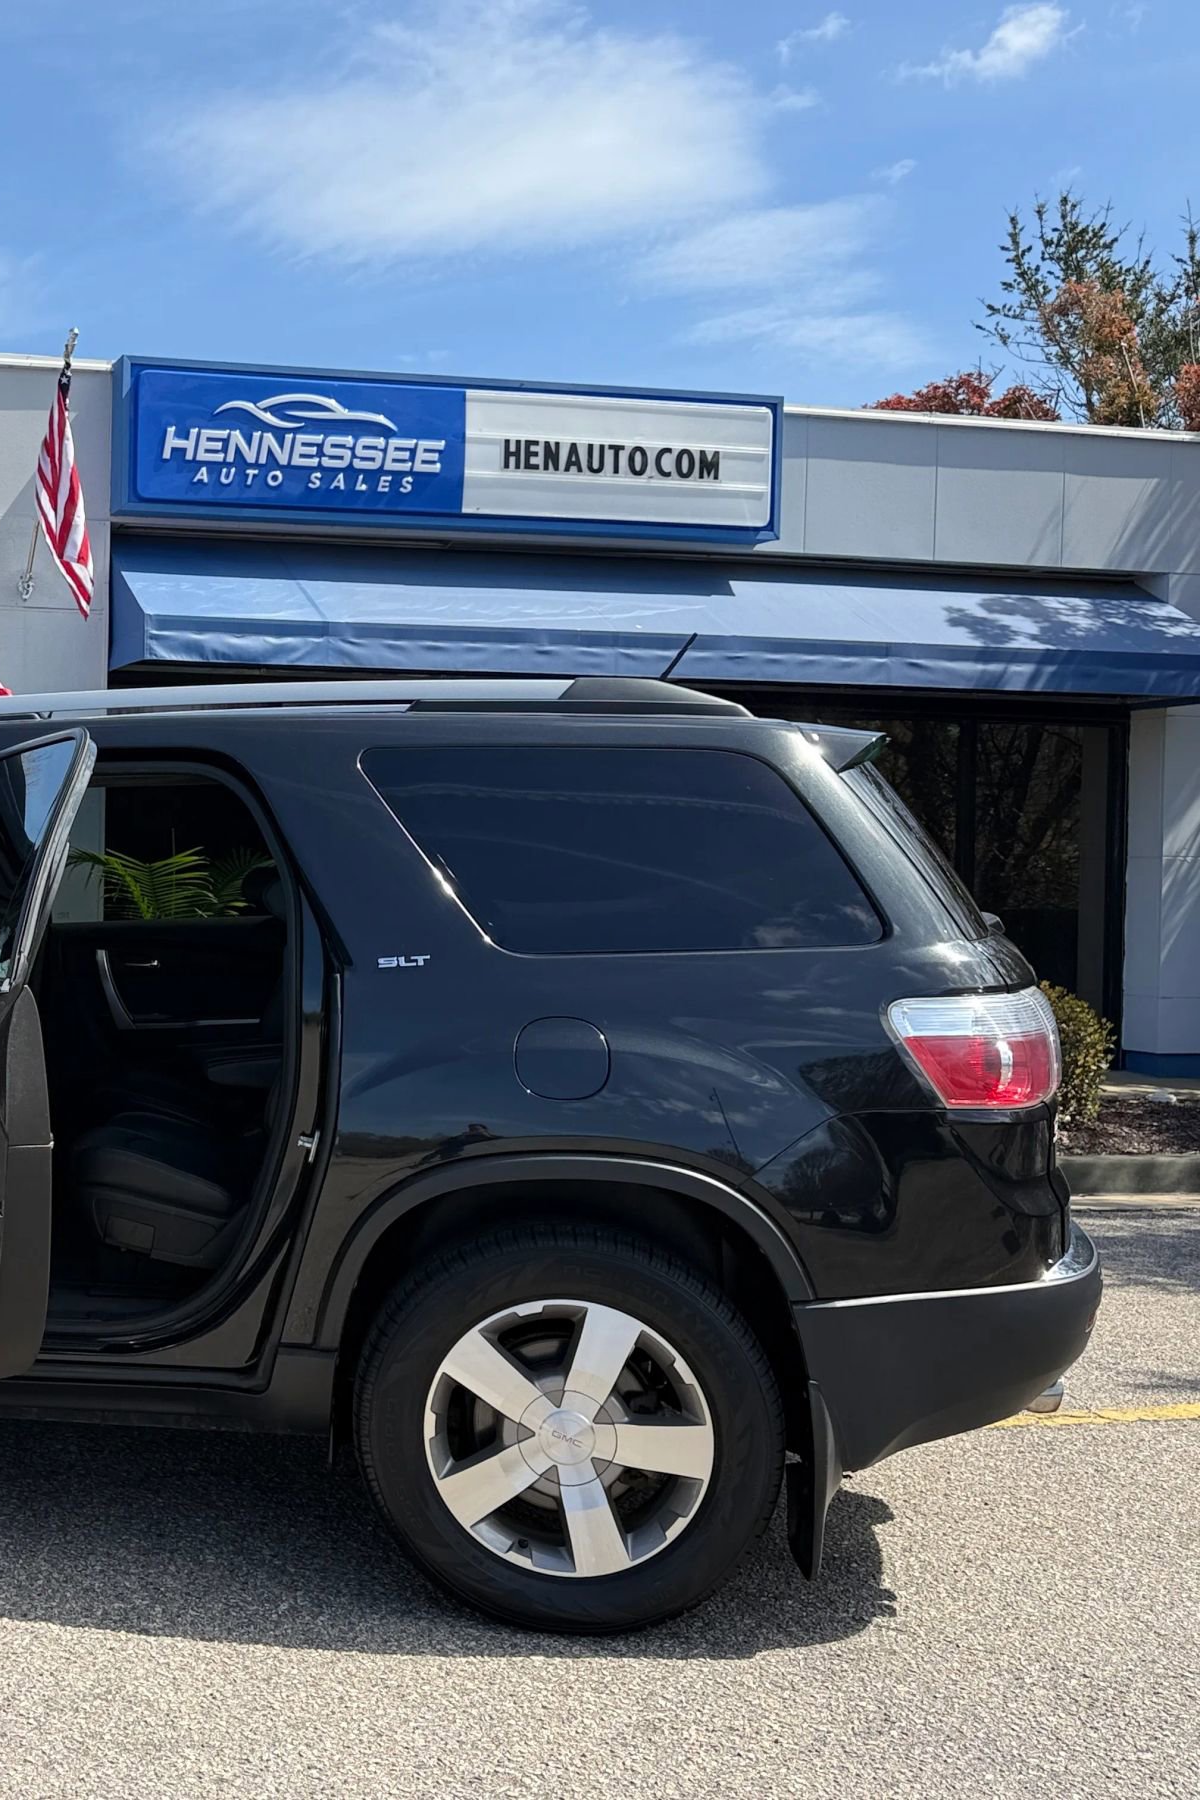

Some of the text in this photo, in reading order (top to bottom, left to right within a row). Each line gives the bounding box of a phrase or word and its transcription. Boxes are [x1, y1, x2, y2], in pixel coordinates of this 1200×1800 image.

[162, 426, 446, 473] HENNESSEE
[503, 439, 721, 481] HENAUTO.COM
[193, 466, 414, 494] AUTO SALES
[377, 954, 431, 969] SLT
[551, 1429, 585, 1449] GMC
